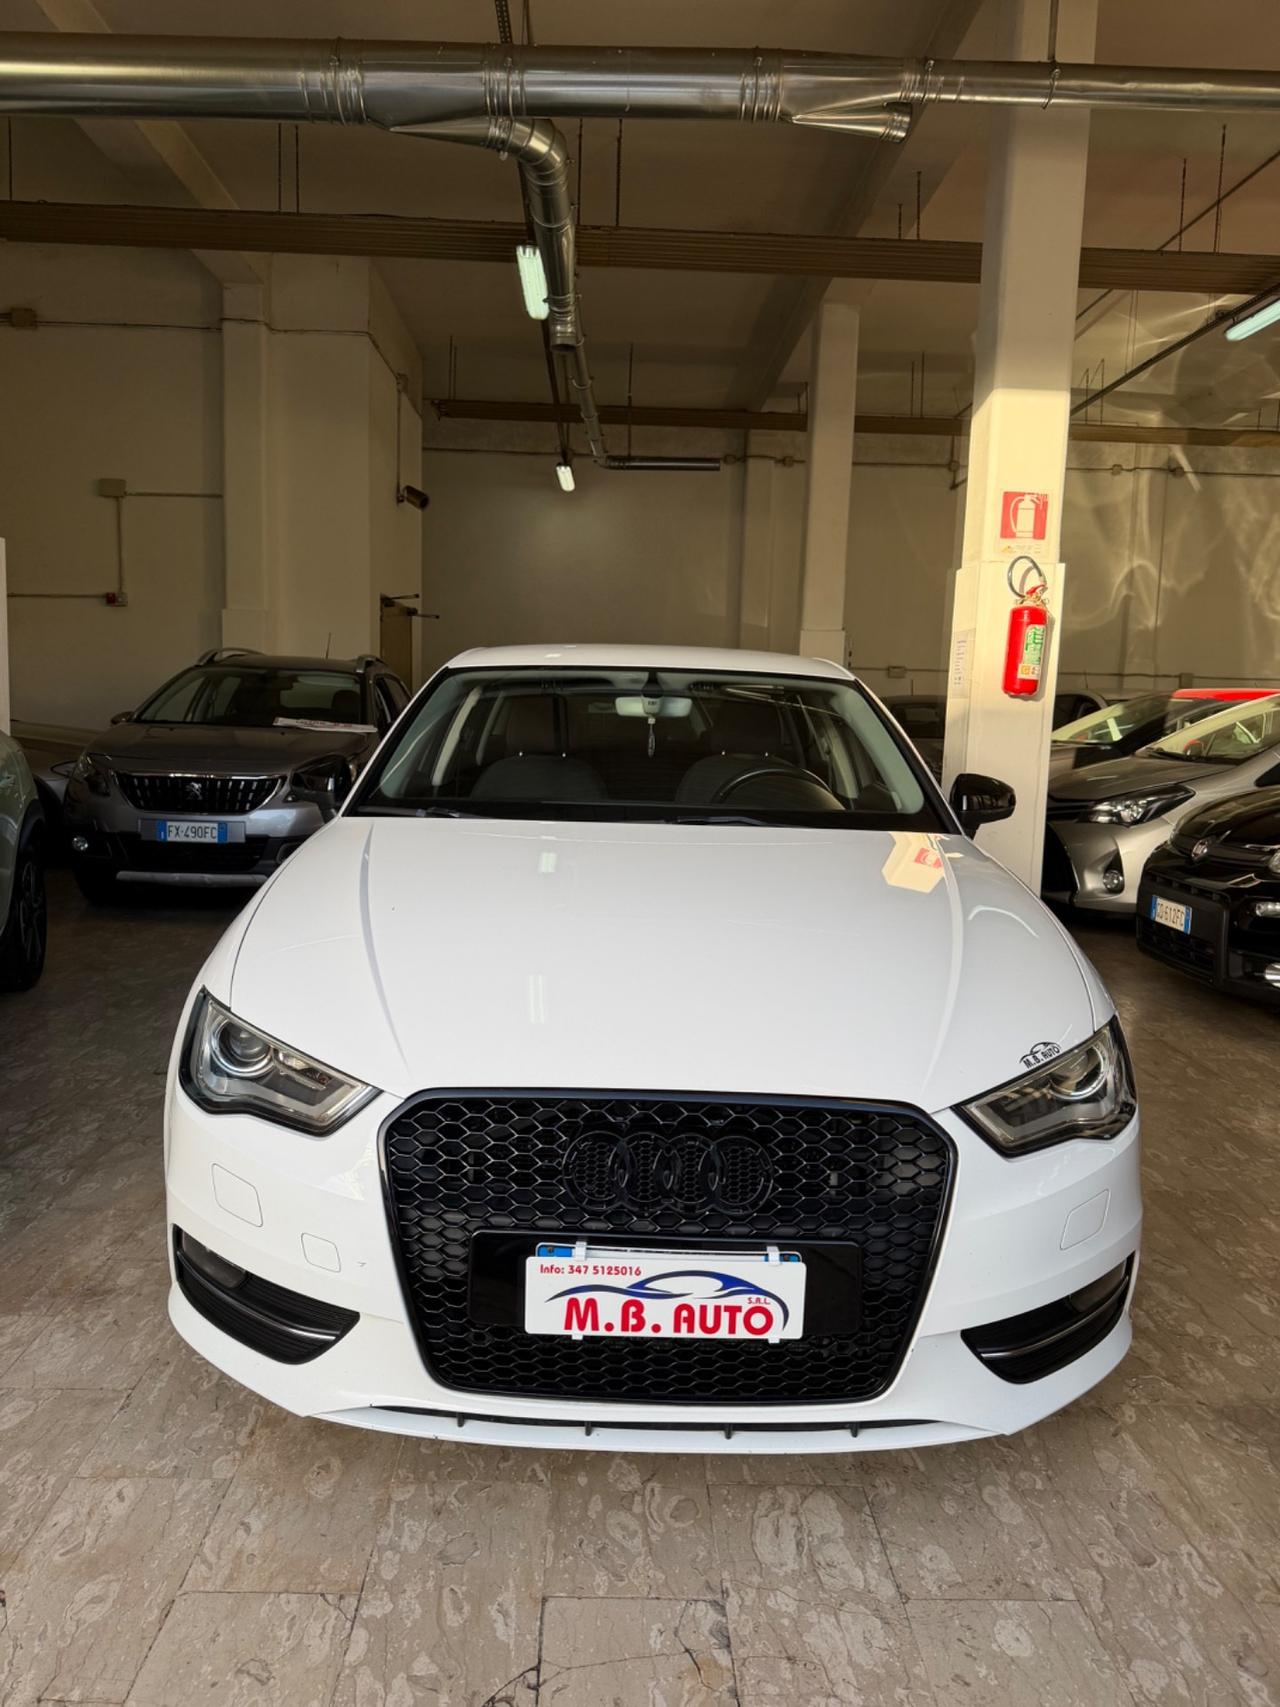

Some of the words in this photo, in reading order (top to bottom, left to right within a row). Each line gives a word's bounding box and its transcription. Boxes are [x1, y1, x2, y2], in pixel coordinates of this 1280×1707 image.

[1041, 1045, 1060, 1060] AUTO
[539, 1264, 565, 1275] Info:
[568, 1264, 589, 1275] 347
[592, 1264, 642, 1276] 5125016
[673, 1303, 774, 1336] AUTO
